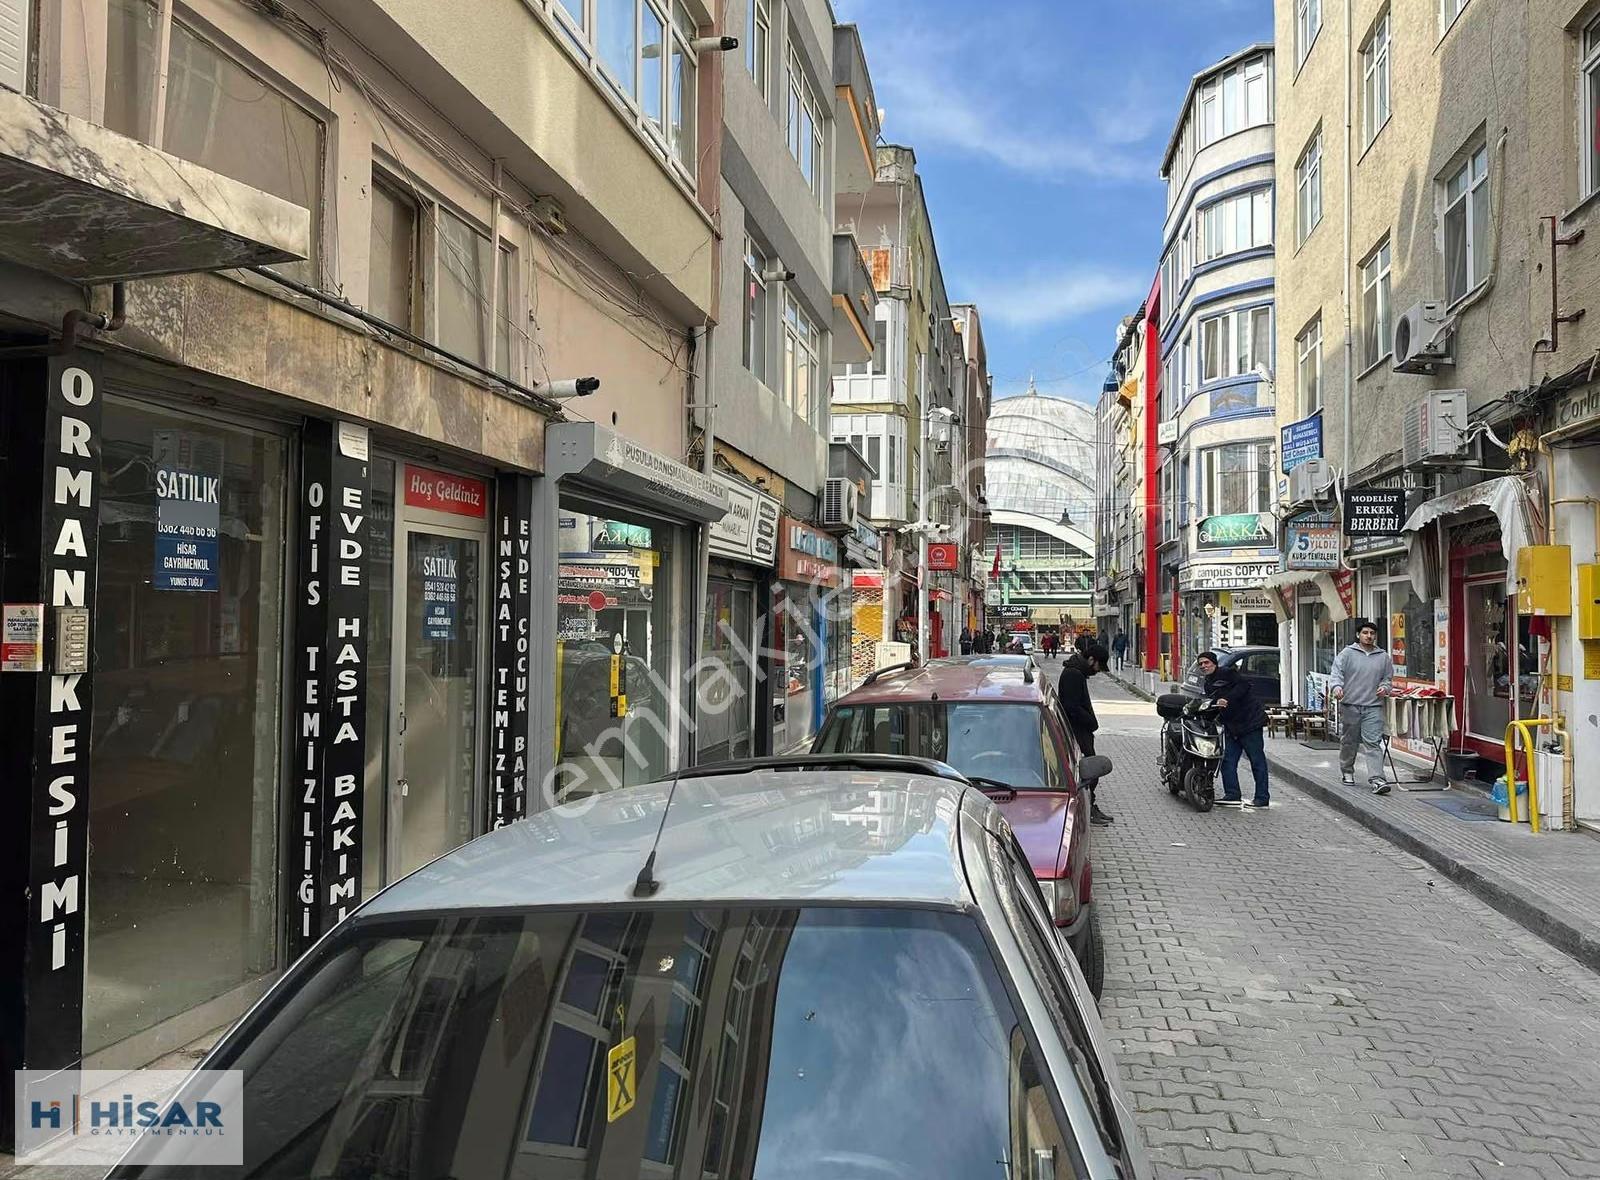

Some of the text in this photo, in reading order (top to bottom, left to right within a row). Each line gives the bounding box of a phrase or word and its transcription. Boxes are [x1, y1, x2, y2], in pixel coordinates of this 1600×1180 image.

[625, 444, 653, 469] PUSULA
[156, 469, 218, 504] SATILIK
[410, 473, 481, 506] Hoş Geldiniz
[1351, 494, 1399, 503] MODELİST
[1350, 514, 1400, 531] BERBERİ
[1355, 505, 1394, 515] ERKEK
[176, 542, 197, 556] HİSAR
[340, 487, 363, 586] EVDE
[1297, 532, 1310, 551] 5
[1311, 540, 1337, 550] YILDIZ
[163, 556, 210, 571] GAYRİMENKUL
[423, 556, 457, 578] SATILIK
[518, 519, 529, 594] EVDE
[1235, 565, 1262, 576] COPY
[498, 516, 511, 642] İNŞAAT
[41, 367, 94, 971] ORMAN KESİMİ
[516, 617, 528, 713] ÇOCUK
[333, 617, 361, 744] HASTA
[300, 482, 323, 937] OFİS TEMİZLİĞİ
